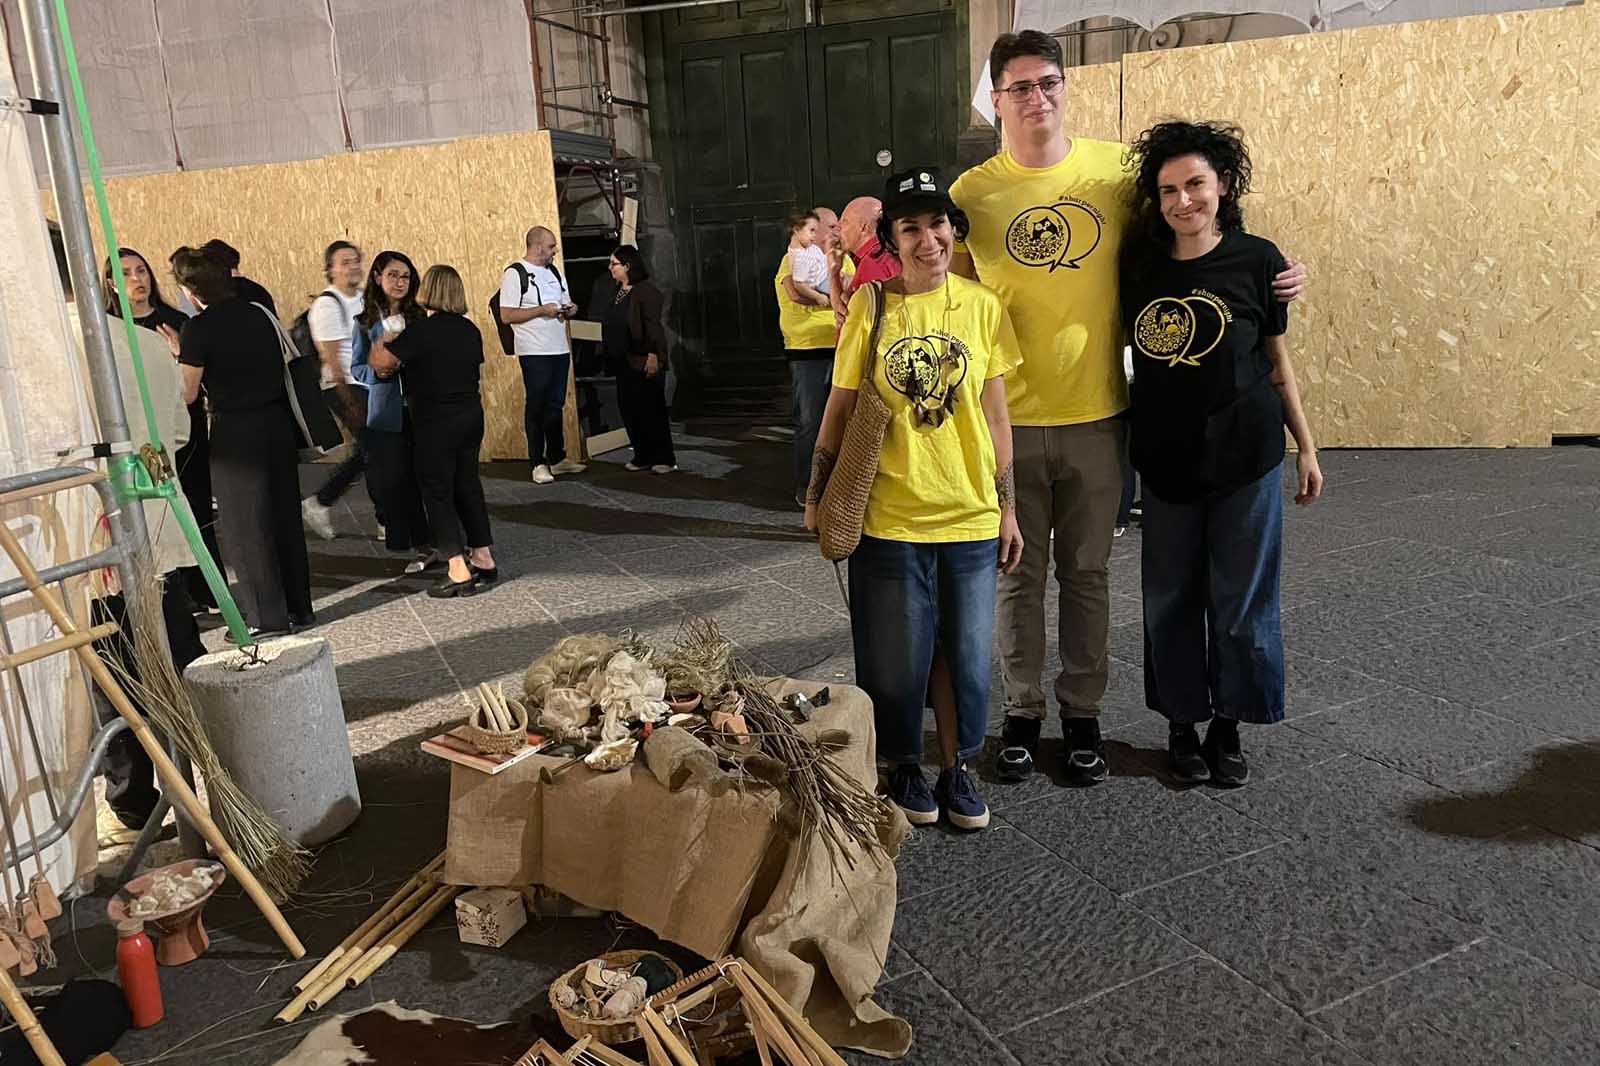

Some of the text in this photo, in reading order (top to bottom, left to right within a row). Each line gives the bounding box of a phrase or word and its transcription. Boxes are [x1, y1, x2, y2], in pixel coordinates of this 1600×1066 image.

[1058, 195, 1106, 225] #sharpernight
[1191, 288, 1233, 323] #sharpernight
[931, 328, 973, 361] #shapernight
